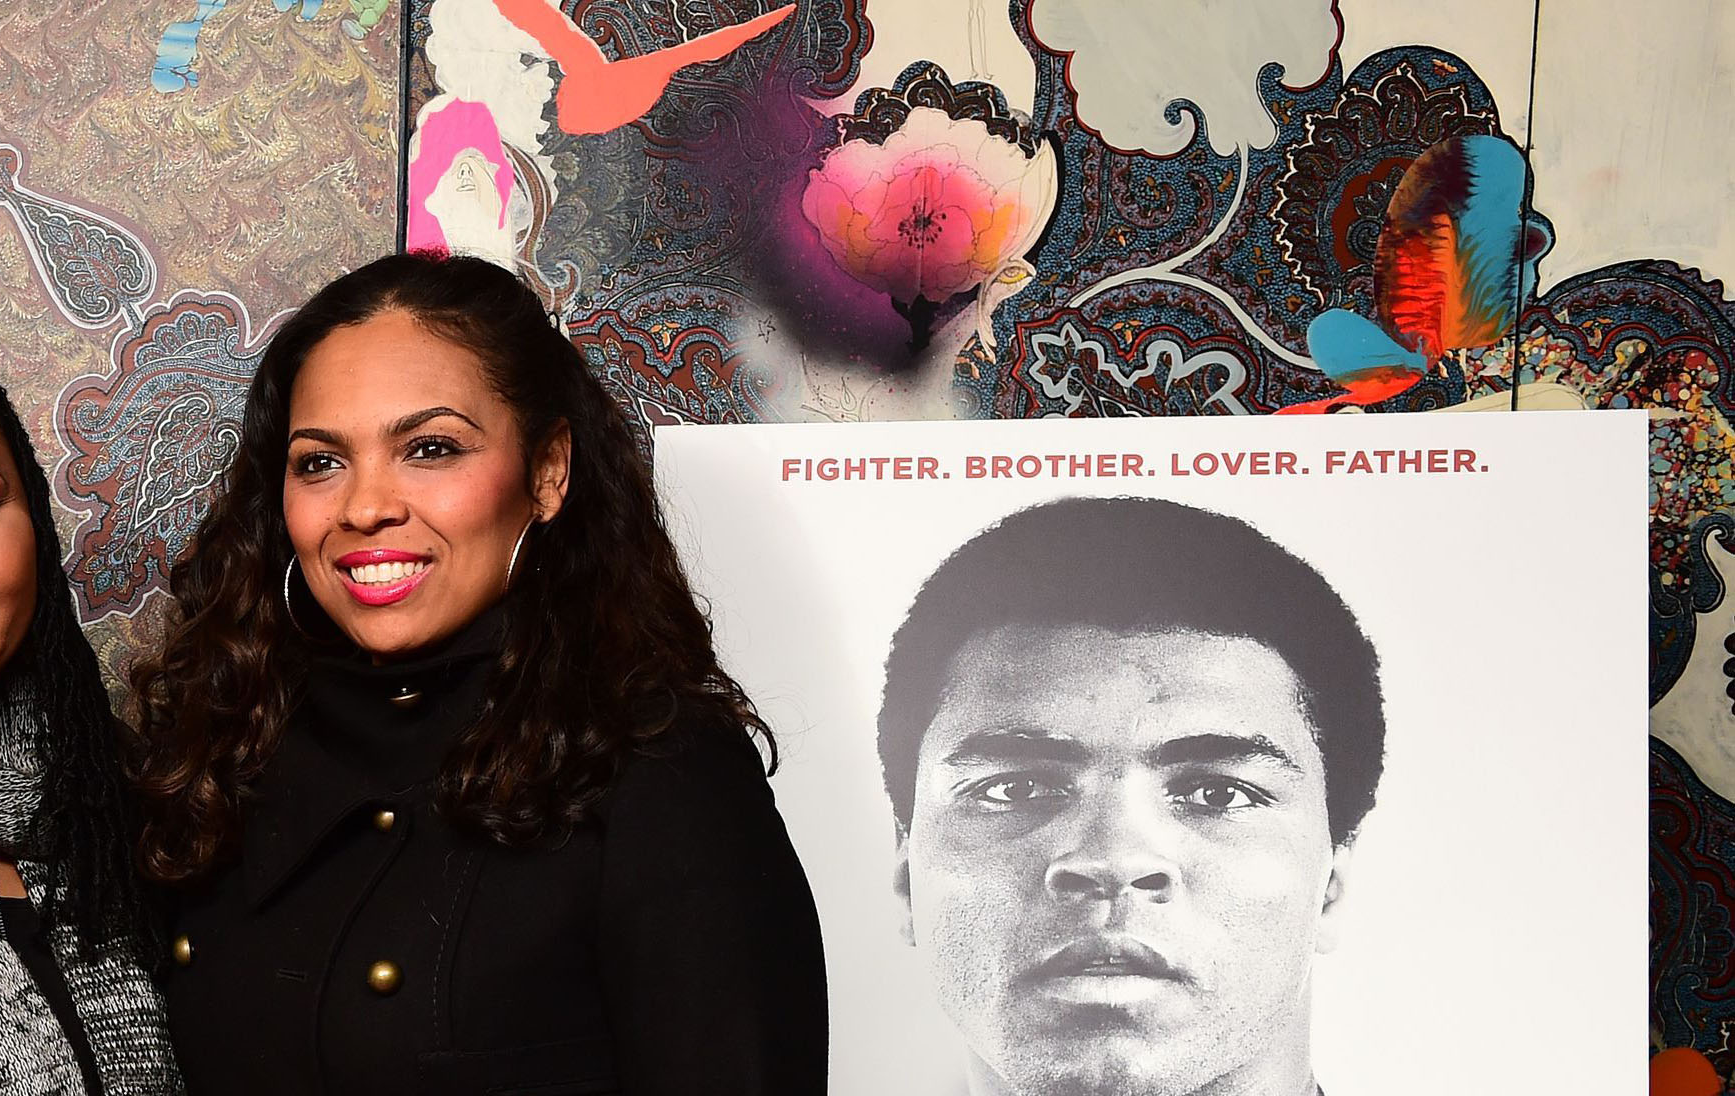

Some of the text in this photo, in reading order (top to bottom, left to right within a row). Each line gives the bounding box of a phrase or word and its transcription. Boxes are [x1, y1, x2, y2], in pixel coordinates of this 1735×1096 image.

[781, 448, 1489, 481] FIGHTER. BROTHER. LOVER. FATHER.
